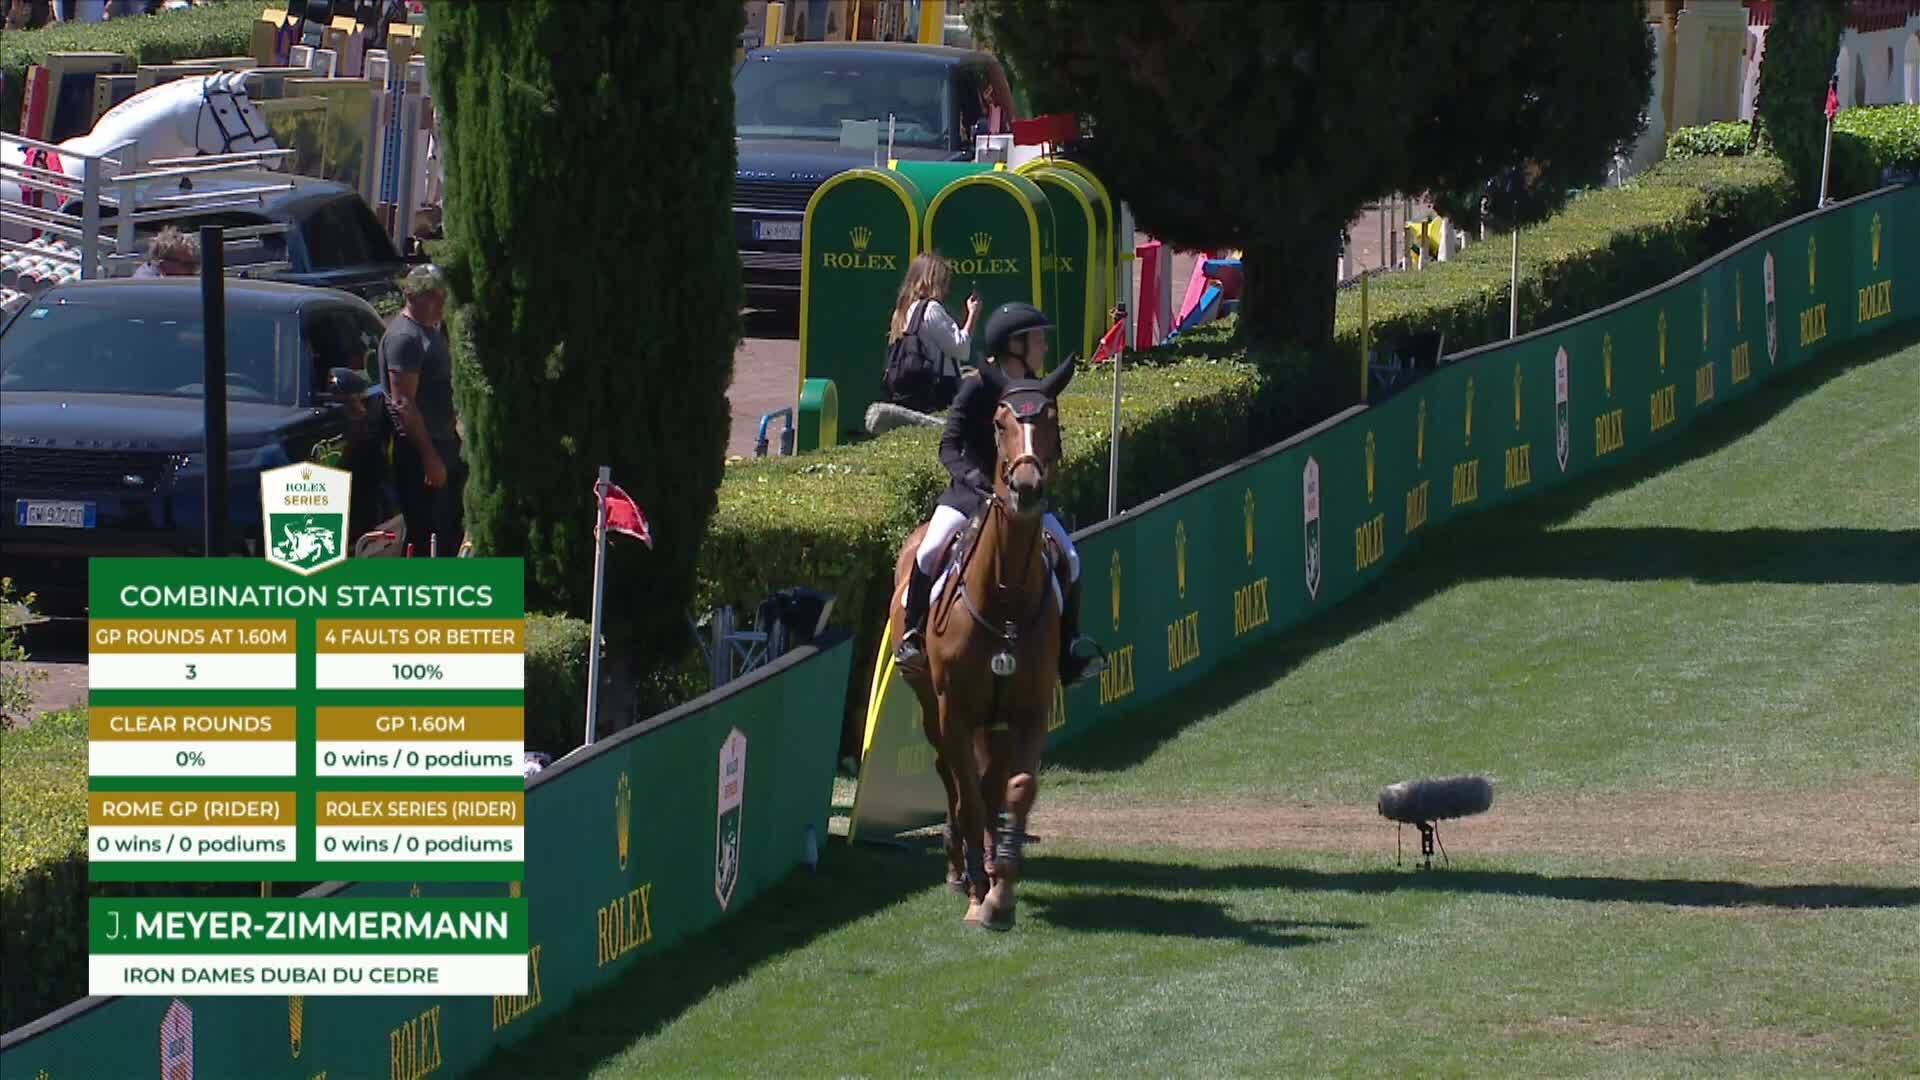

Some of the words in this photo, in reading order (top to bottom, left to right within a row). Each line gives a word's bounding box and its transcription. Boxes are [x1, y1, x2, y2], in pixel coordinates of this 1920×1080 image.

[823, 252, 896, 270] ROLEX
[1800, 303, 1827, 347] ROLEX
[1858, 280, 1892, 323] ROLEX
[1595, 408, 1624, 456] ROLEX
[1356, 512, 1384, 571] ROLEX
[1234, 576, 1269, 637] ROLEX
[1168, 610, 1200, 672] ROLEX
[597, 883, 652, 968] ROLEX
[390, 1004, 441, 1080] ROLEX
